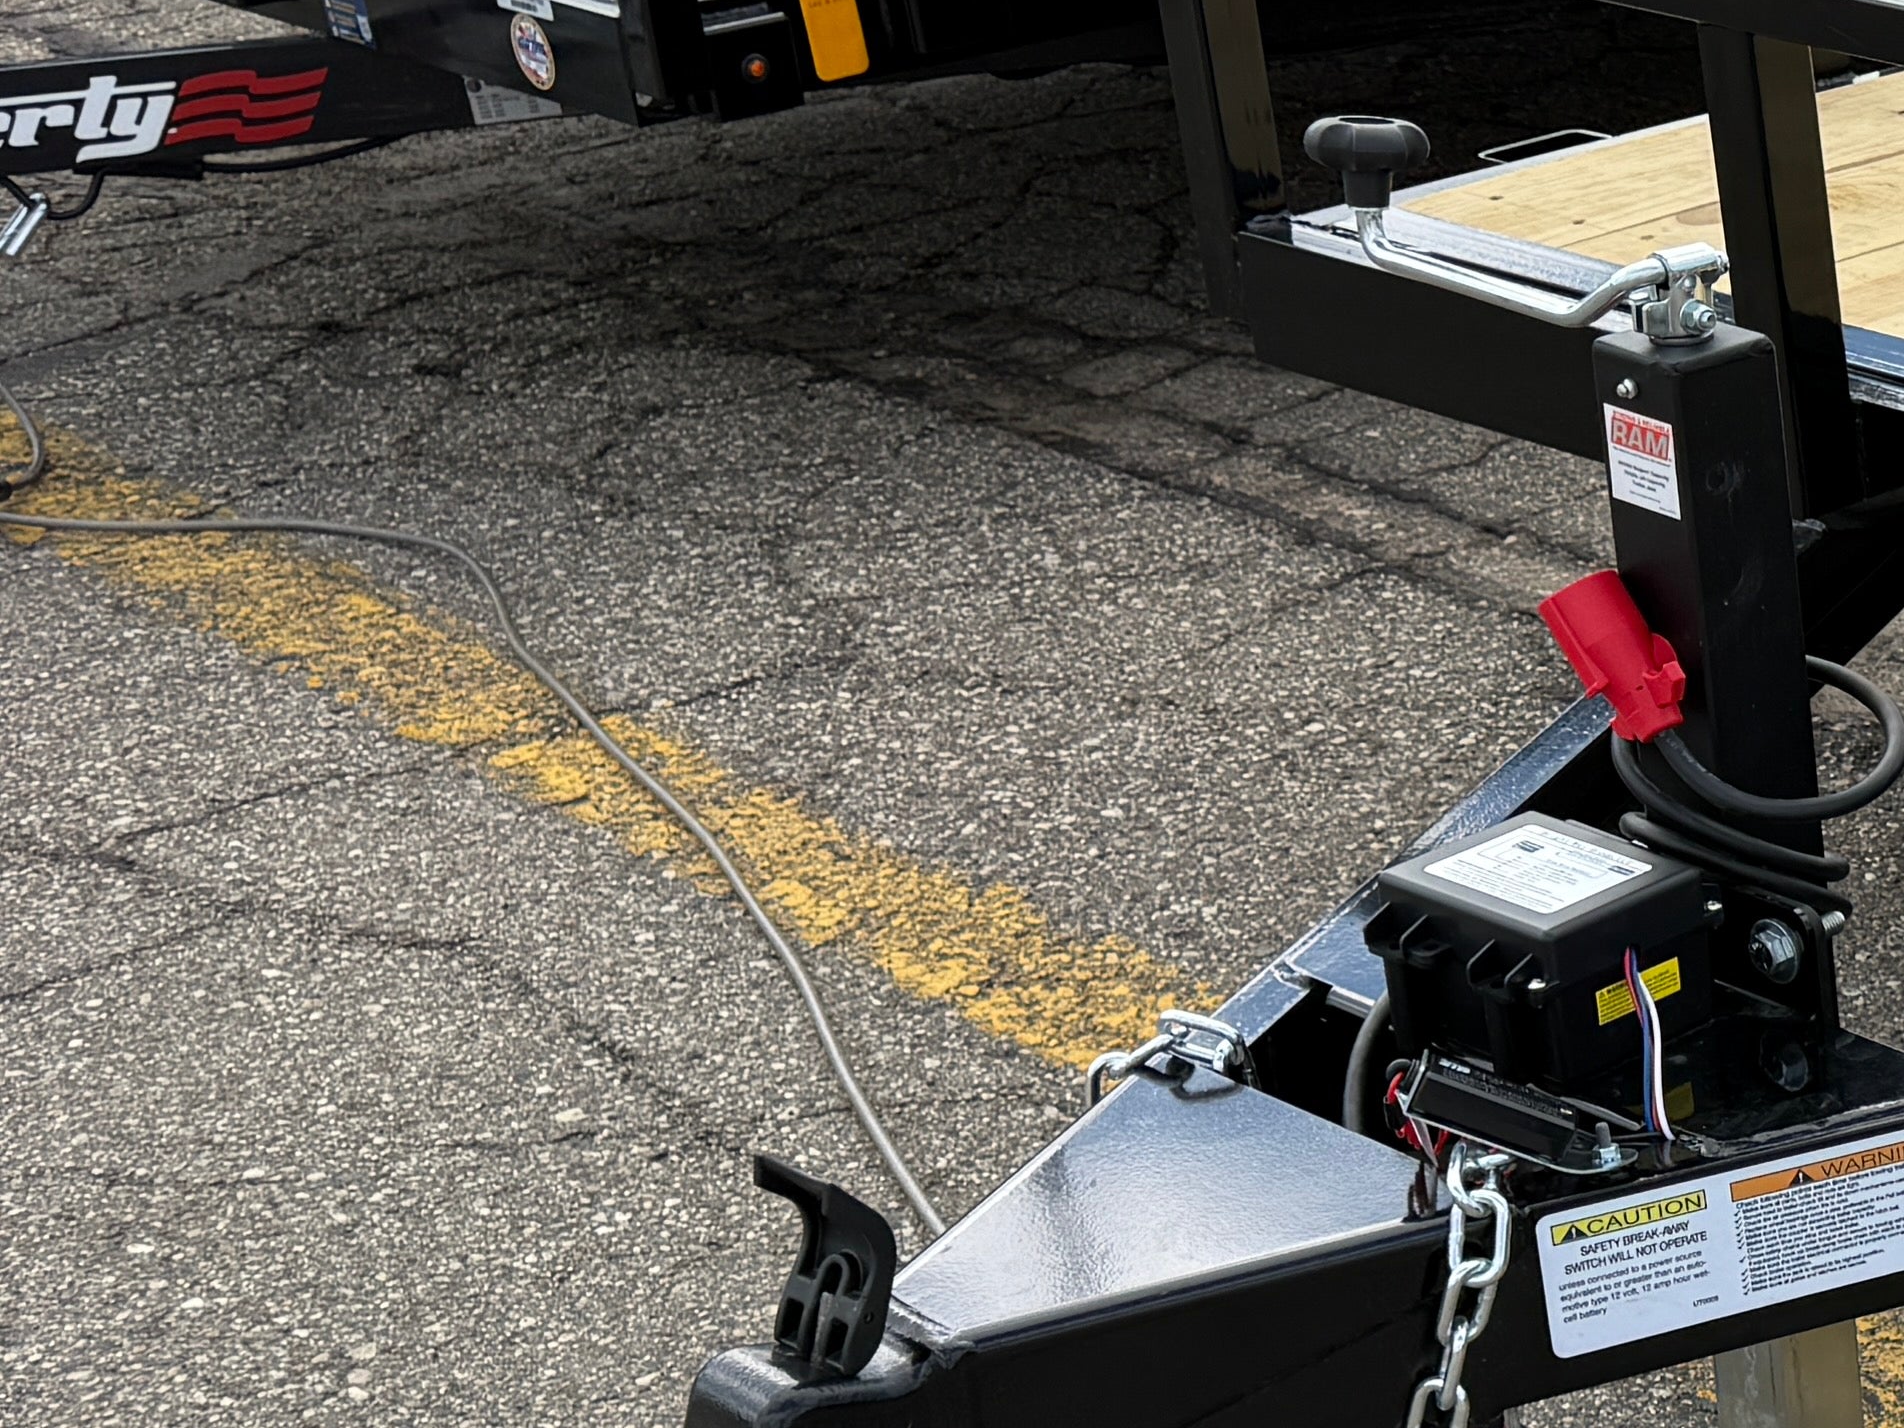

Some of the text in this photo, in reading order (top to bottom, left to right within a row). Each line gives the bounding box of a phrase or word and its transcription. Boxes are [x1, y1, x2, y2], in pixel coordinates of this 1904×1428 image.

[0, 75, 177, 163] rty
[1612, 420, 1668, 460] RAM
[1587, 1194, 1701, 1234] CAUTION
[1564, 1231, 1708, 1275] SWITCH WILL NOT OPERATE
[1580, 1220, 1690, 1256] SAFETY BREAK-AWAY
